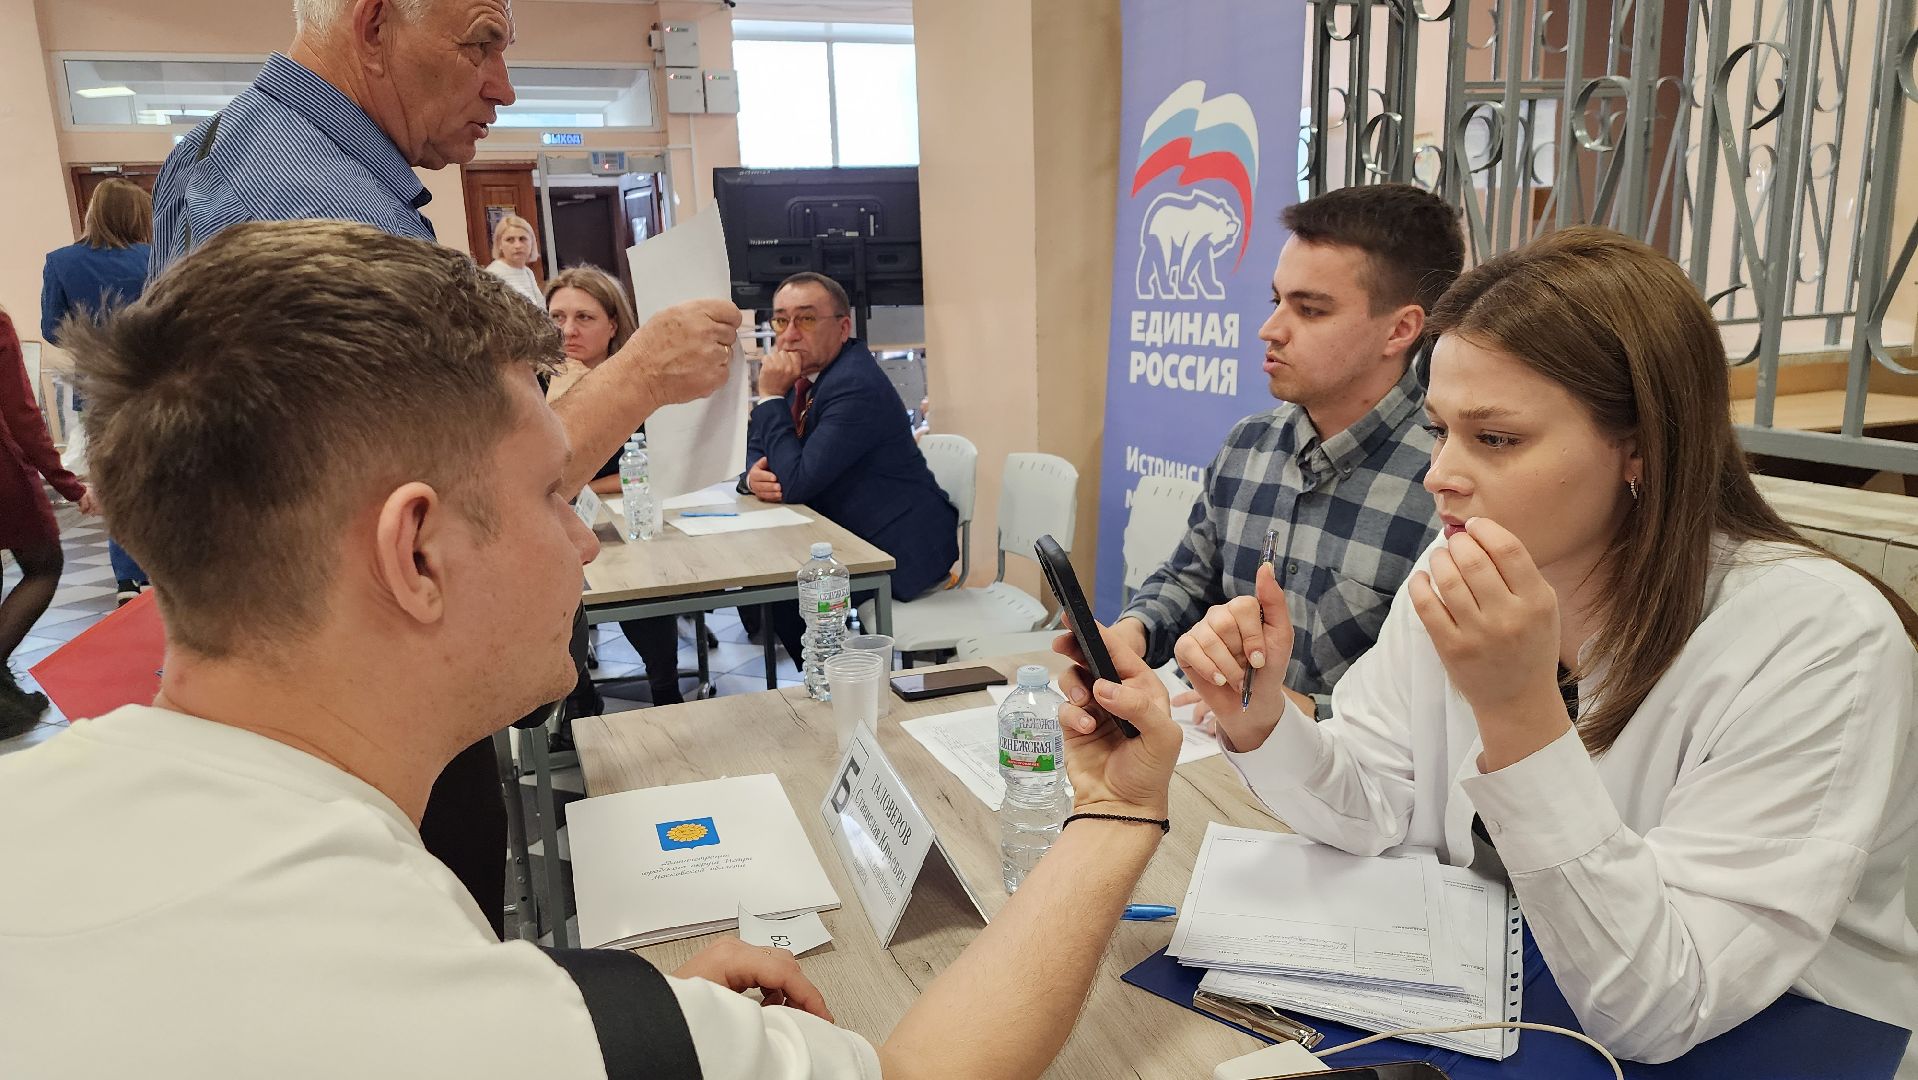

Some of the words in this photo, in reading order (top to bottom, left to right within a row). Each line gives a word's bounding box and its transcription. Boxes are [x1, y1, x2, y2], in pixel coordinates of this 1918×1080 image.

[1130, 310, 1240, 348] ЕДИНАЯ
[1129, 351, 1239, 396] РОССИЯ
[830, 755, 860, 814] Б
[870, 773, 913, 846] ТАЛОВЕРОВ
[855, 788, 880, 840] Станислав
